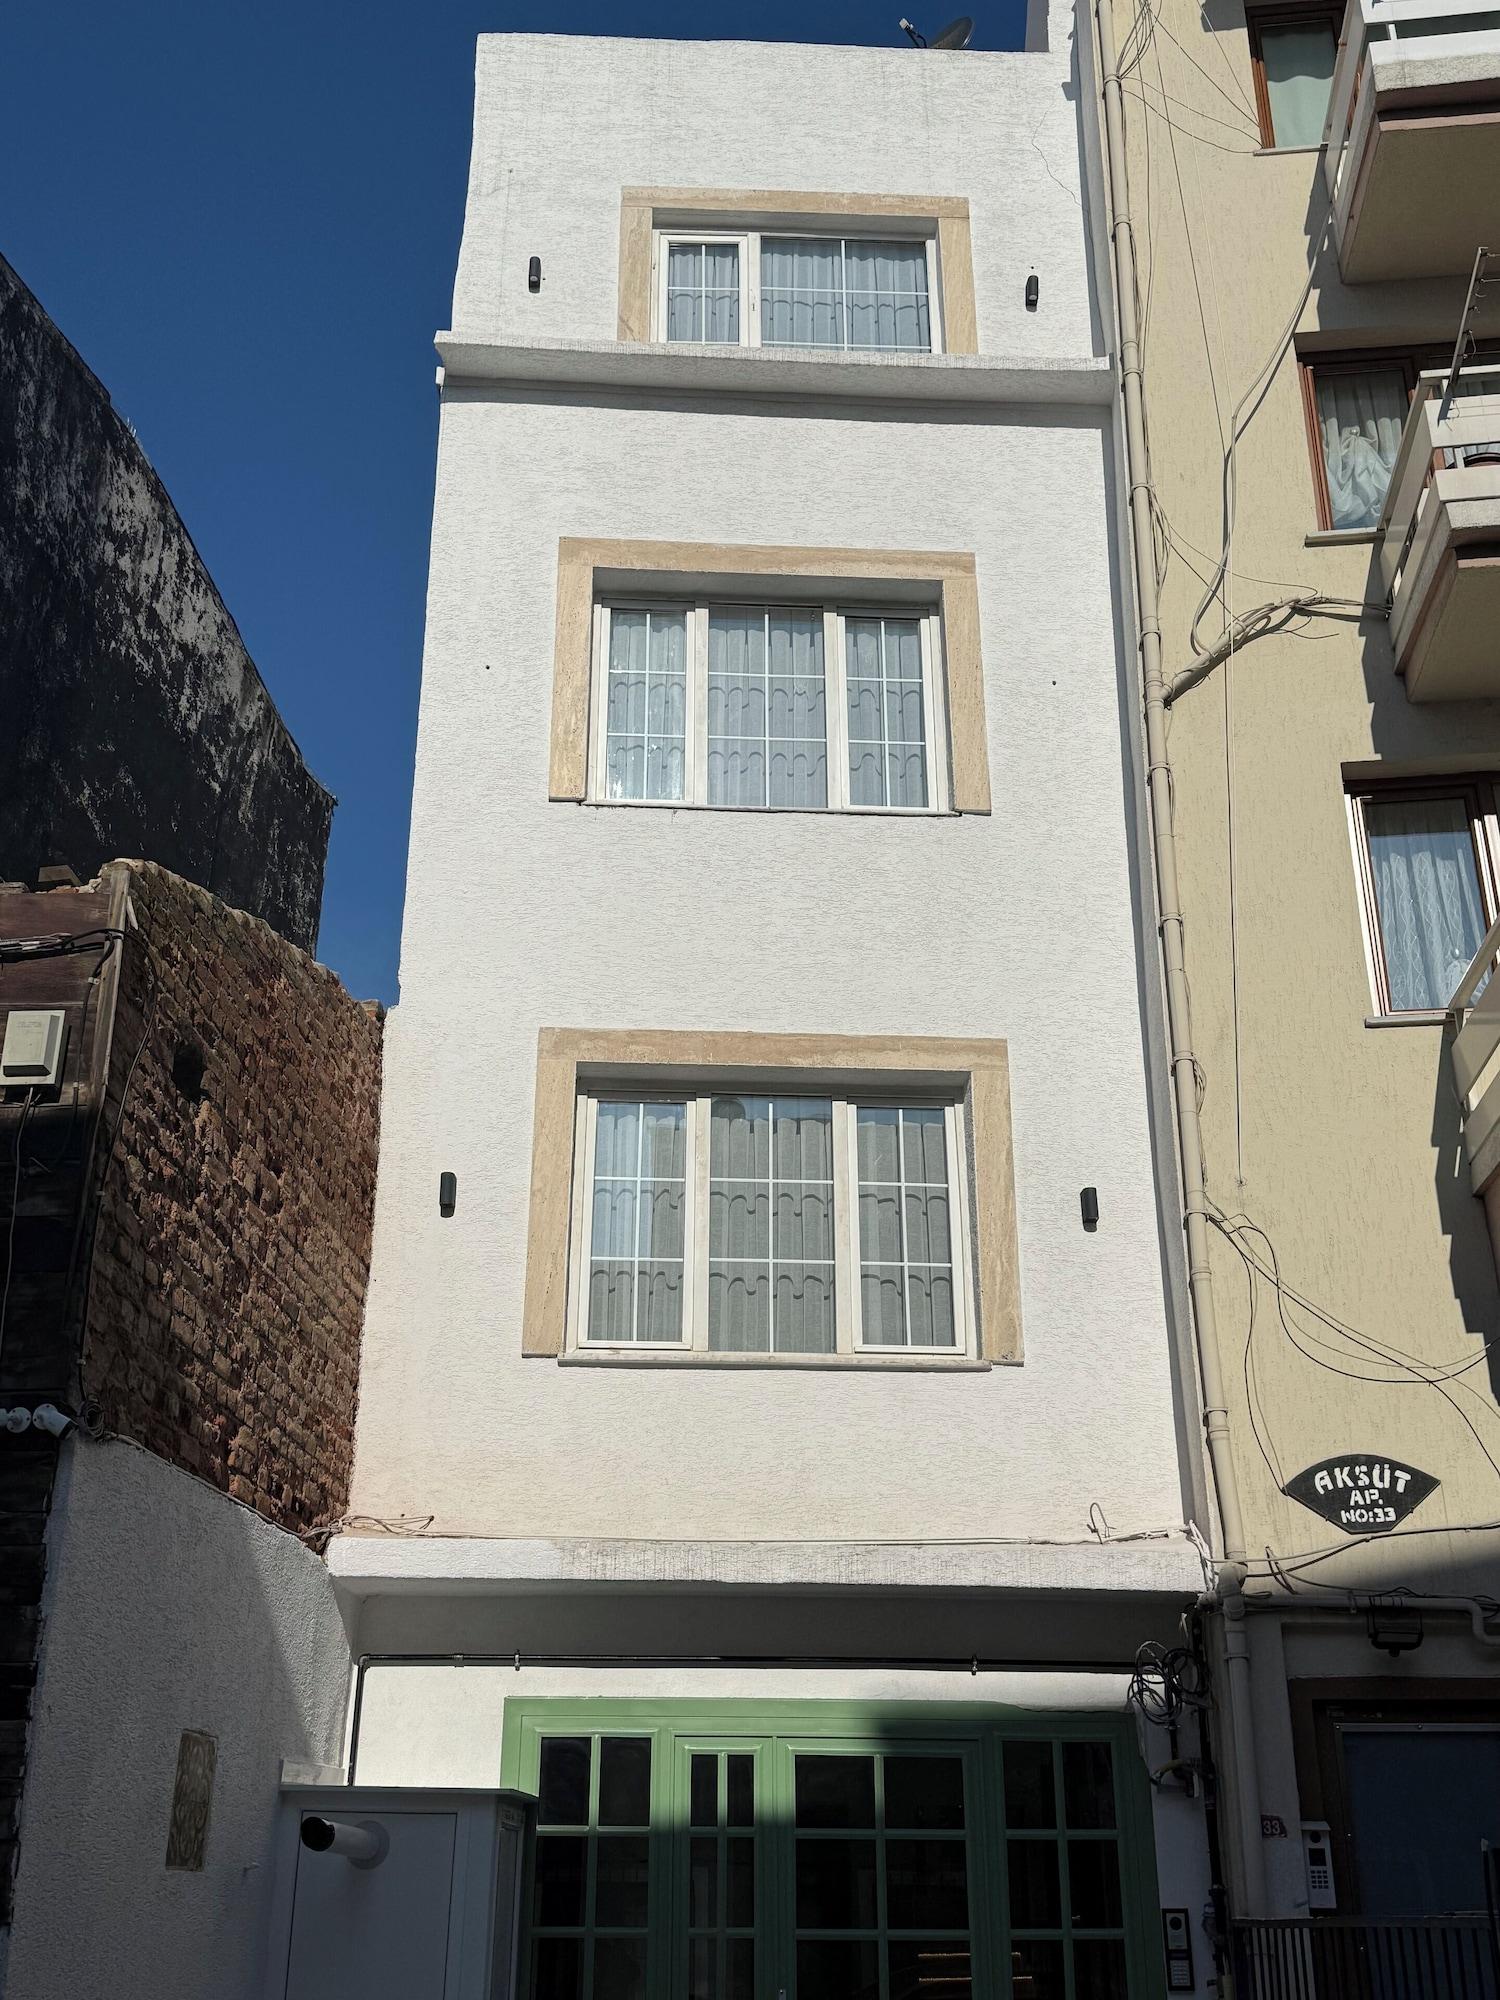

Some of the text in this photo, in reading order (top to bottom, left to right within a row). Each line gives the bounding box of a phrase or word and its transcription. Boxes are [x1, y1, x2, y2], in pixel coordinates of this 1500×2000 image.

[1314, 1463, 1412, 1495] AKSÜT
[1350, 1488, 1383, 1506] AP.
[1340, 1507, 1396, 1523] NO:33
[1263, 1820, 1280, 1834] 33
